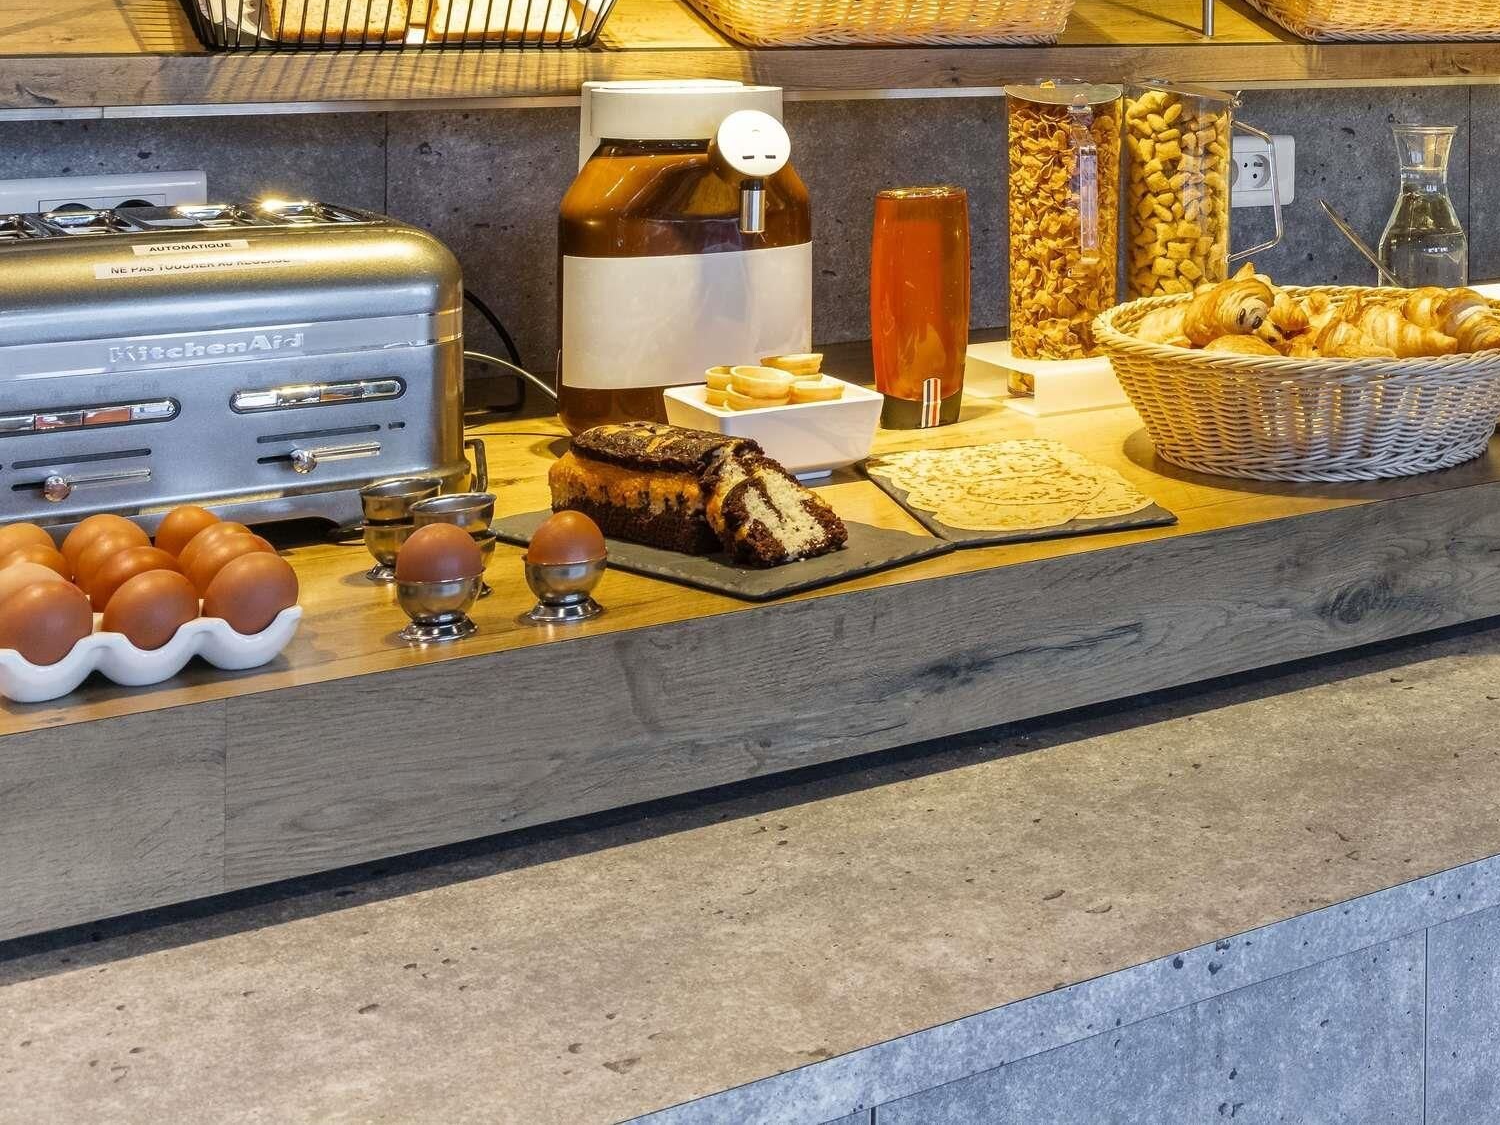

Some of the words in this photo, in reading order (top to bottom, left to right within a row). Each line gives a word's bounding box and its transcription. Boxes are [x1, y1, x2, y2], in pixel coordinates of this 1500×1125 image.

[149, 242, 232, 253] AUTOMATIQUE
[111, 266, 128, 274] NE
[131, 265, 154, 274] PAS
[109, 333, 304, 363] KitchenAid
